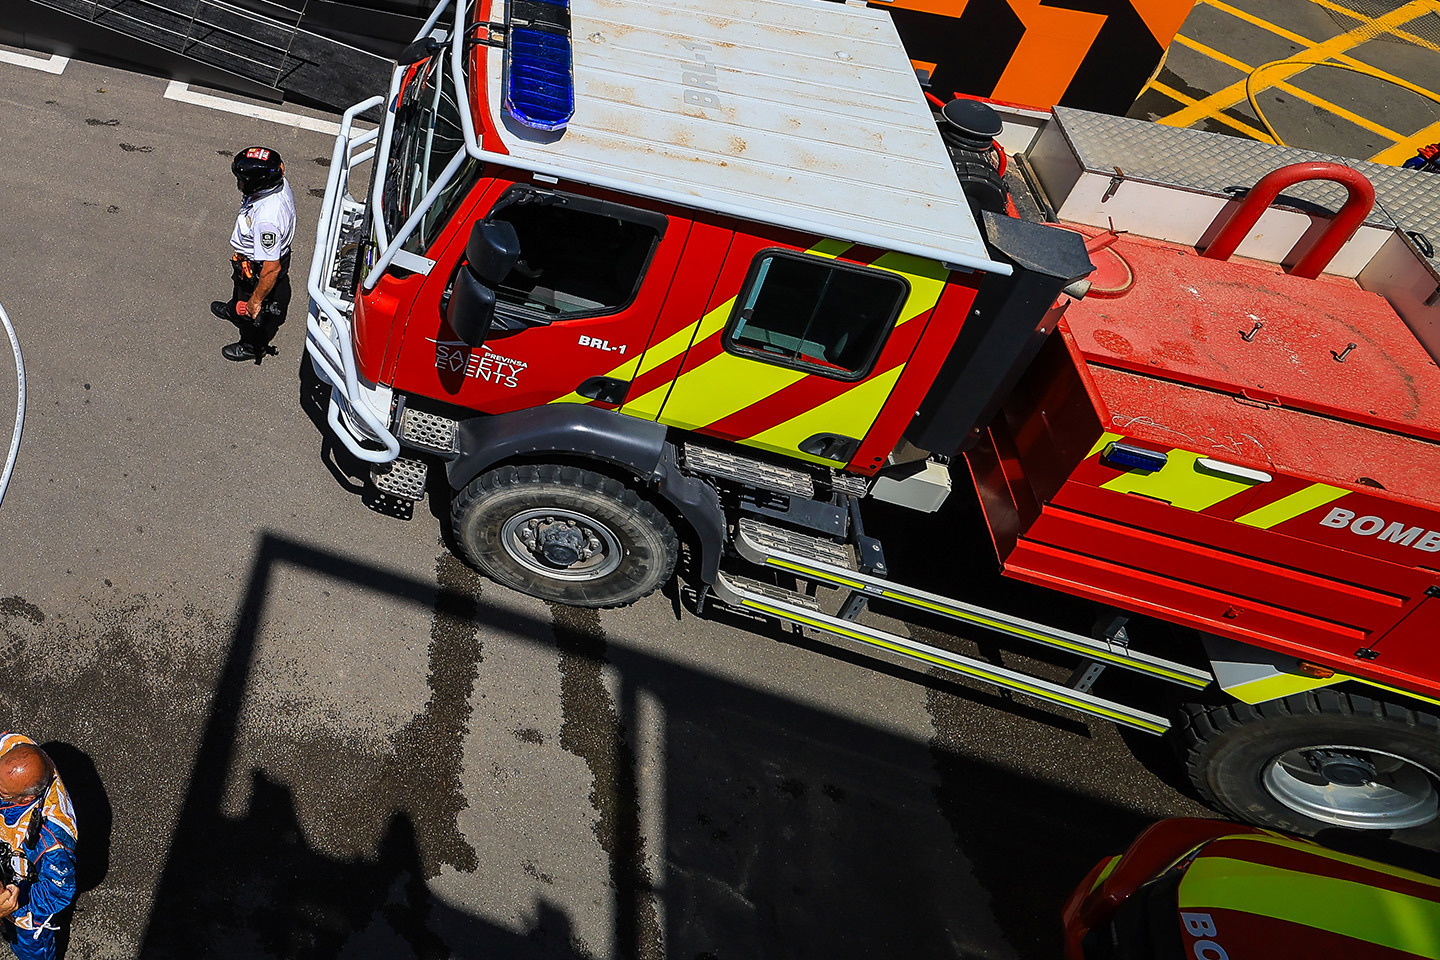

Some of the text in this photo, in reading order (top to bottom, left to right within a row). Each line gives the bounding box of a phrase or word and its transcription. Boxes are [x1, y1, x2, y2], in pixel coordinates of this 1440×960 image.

[681, 40, 721, 110] BRL-1
[435, 344, 525, 378] SAFETY
[484, 352, 529, 368] PREVINSA
[577, 335, 627, 355] BRL-1
[434, 357, 520, 389] EVENTS
